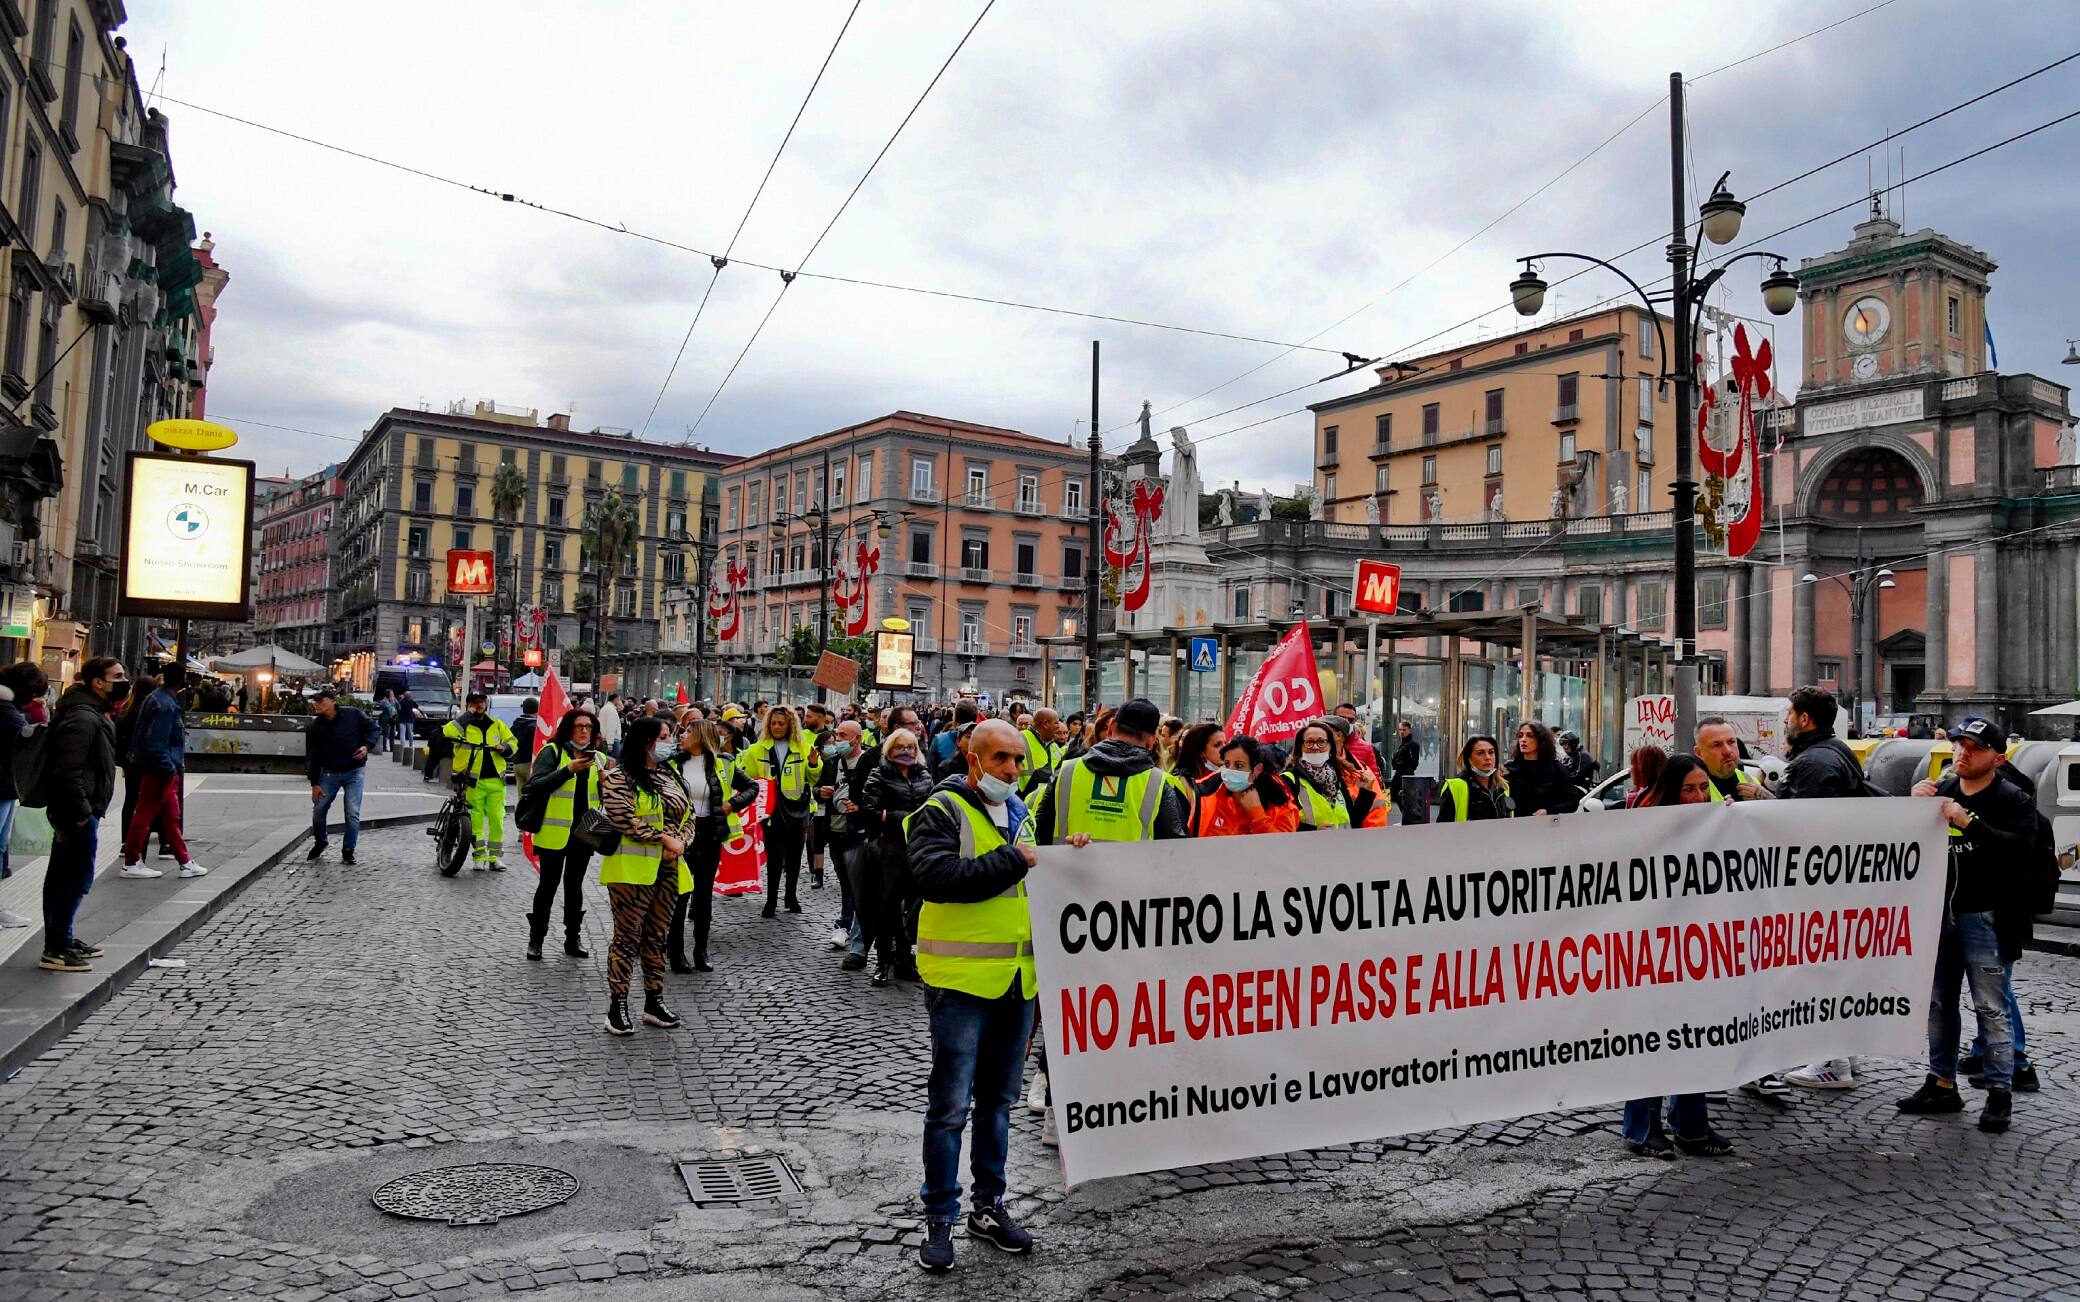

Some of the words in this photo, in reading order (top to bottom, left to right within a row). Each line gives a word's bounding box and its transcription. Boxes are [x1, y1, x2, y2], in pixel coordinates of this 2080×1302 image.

[1810, 403, 1857, 419] CONVITTO
[1863, 393, 1916, 411] NAZIONALE
[163, 427, 193, 436] piazza
[196, 427, 224, 438] Dante
[1809, 413, 1857, 431] VITTORIO
[185, 482, 229, 497] M.Car
[144, 557, 175, 568] Nuovo
[177, 559, 229, 571] Showroom
[455, 558, 487, 585] M
[1363, 572, 1392, 605] M
[1060, 894, 1223, 954] CONTRO
[1233, 891, 1275, 941] LA
[1283, 879, 1415, 936] SVOLTA
[1423, 861, 1622, 923] AUTORITARIA
[1629, 856, 1657, 901] DI
[1664, 847, 1780, 898] PADRONI
[1784, 846, 1801, 886] E
[1804, 842, 1920, 885] GOVERNO
[1061, 983, 1119, 1056] NO
[1129, 979, 1175, 1048] AL
[1184, 966, 1301, 1040] GREEN
[1310, 956, 1397, 1027] PASS
[1405, 954, 1424, 1016] E
[1428, 946, 1505, 1012] ALLA
[1514, 920, 1745, 1001] VACCINAZIONE
[1752, 905, 1912, 970] OBBLIGATORIA
[1067, 1085, 1178, 1133] Banchi
[1187, 1073, 1276, 1116] Nuovi
[1285, 1080, 1301, 1102] e
[1309, 1049, 1457, 1099] Lavoratori
[1465, 1029, 1660, 1077] manutenzione
[1667, 1013, 1759, 1050] stradale
[1761, 997, 1815, 1034] iscritti
[1819, 998, 1836, 1022] SI
[1840, 992, 1910, 1019] Cobas
